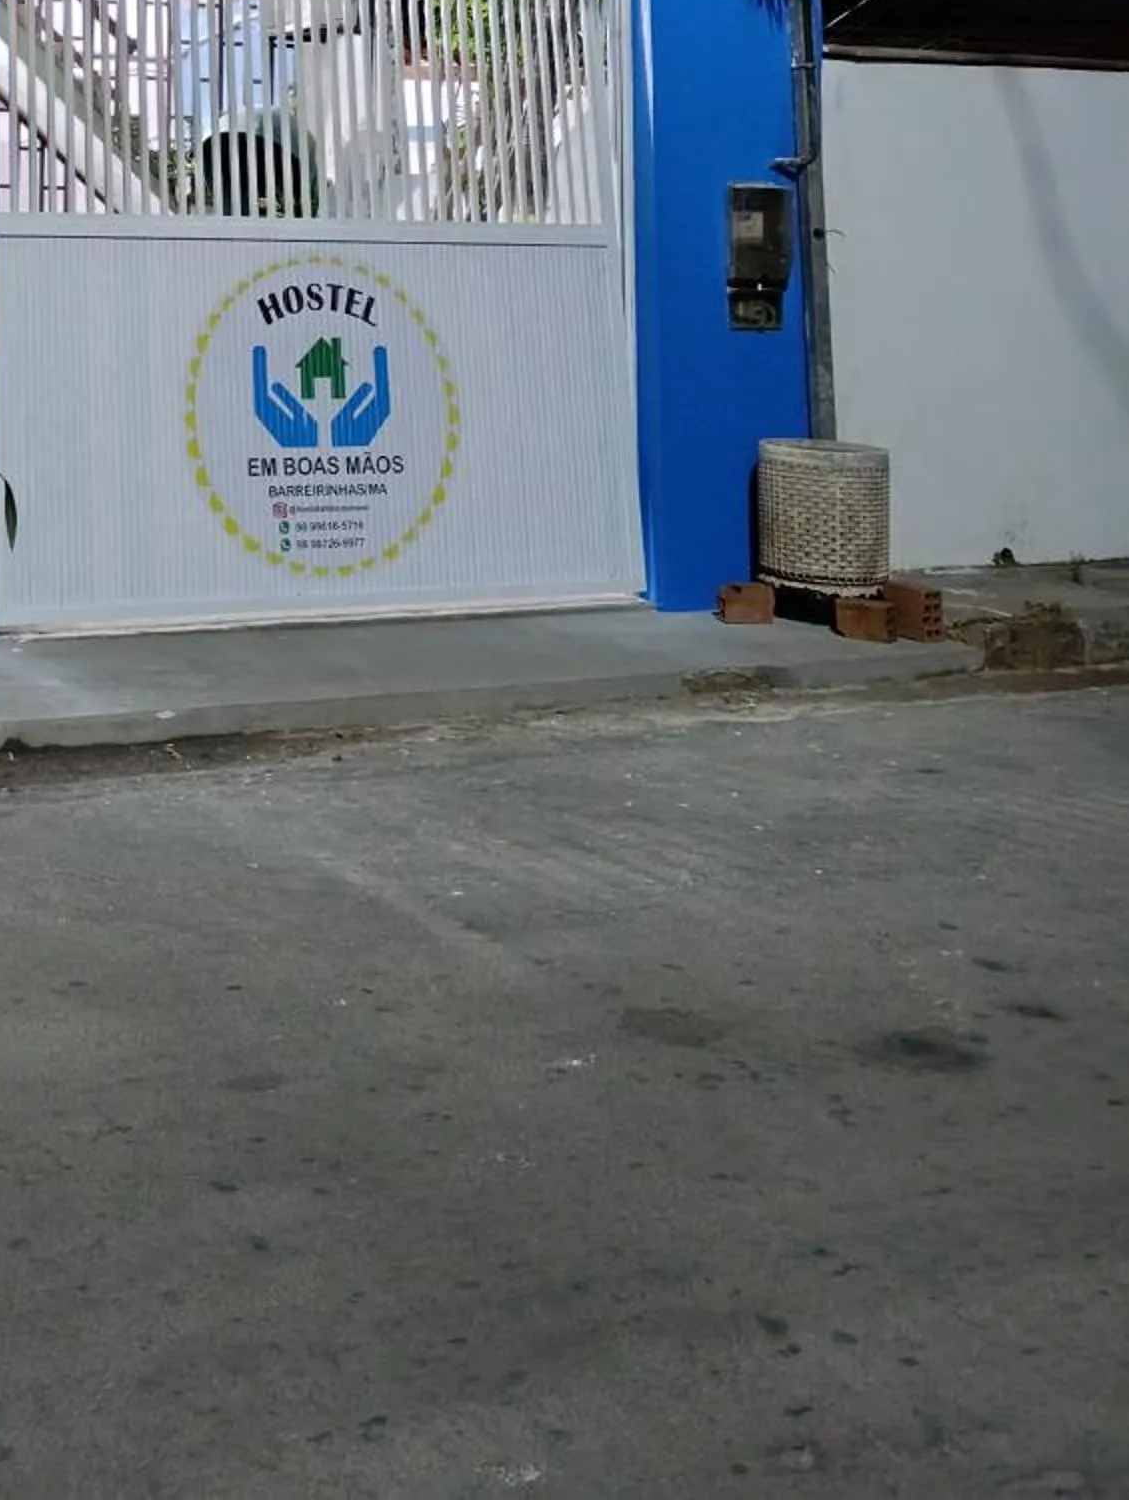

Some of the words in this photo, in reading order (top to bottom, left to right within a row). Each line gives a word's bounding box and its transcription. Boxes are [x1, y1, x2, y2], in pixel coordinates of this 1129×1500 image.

[257, 283, 377, 326] HOSTEL
[247, 457, 277, 477] EM
[283, 455, 340, 476] BOAS
[346, 451, 405, 475] MÃOS
